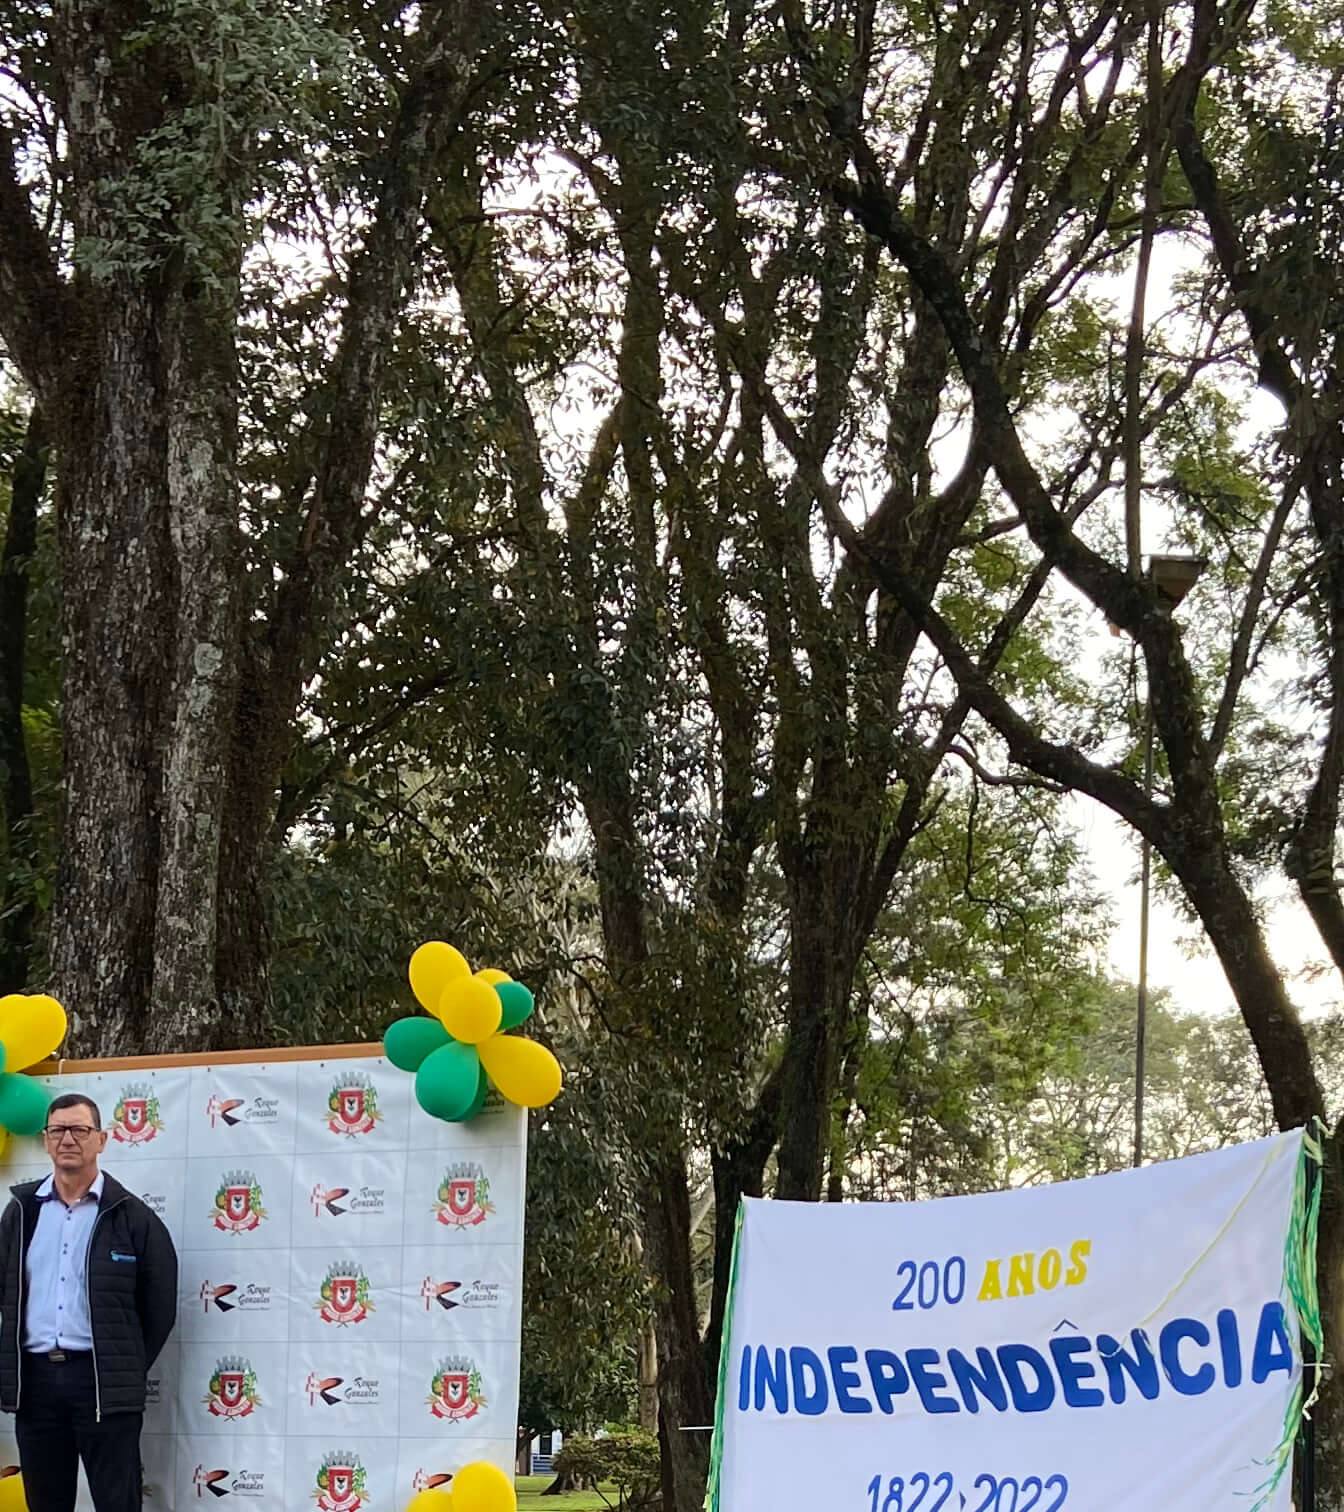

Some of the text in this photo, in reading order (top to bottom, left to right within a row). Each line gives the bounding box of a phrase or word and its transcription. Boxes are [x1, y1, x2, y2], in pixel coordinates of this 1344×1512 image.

[892, 1240, 1092, 1310] 200 ANOS
[738, 1301, 1293, 1415] INDEPENDÊNCIA
